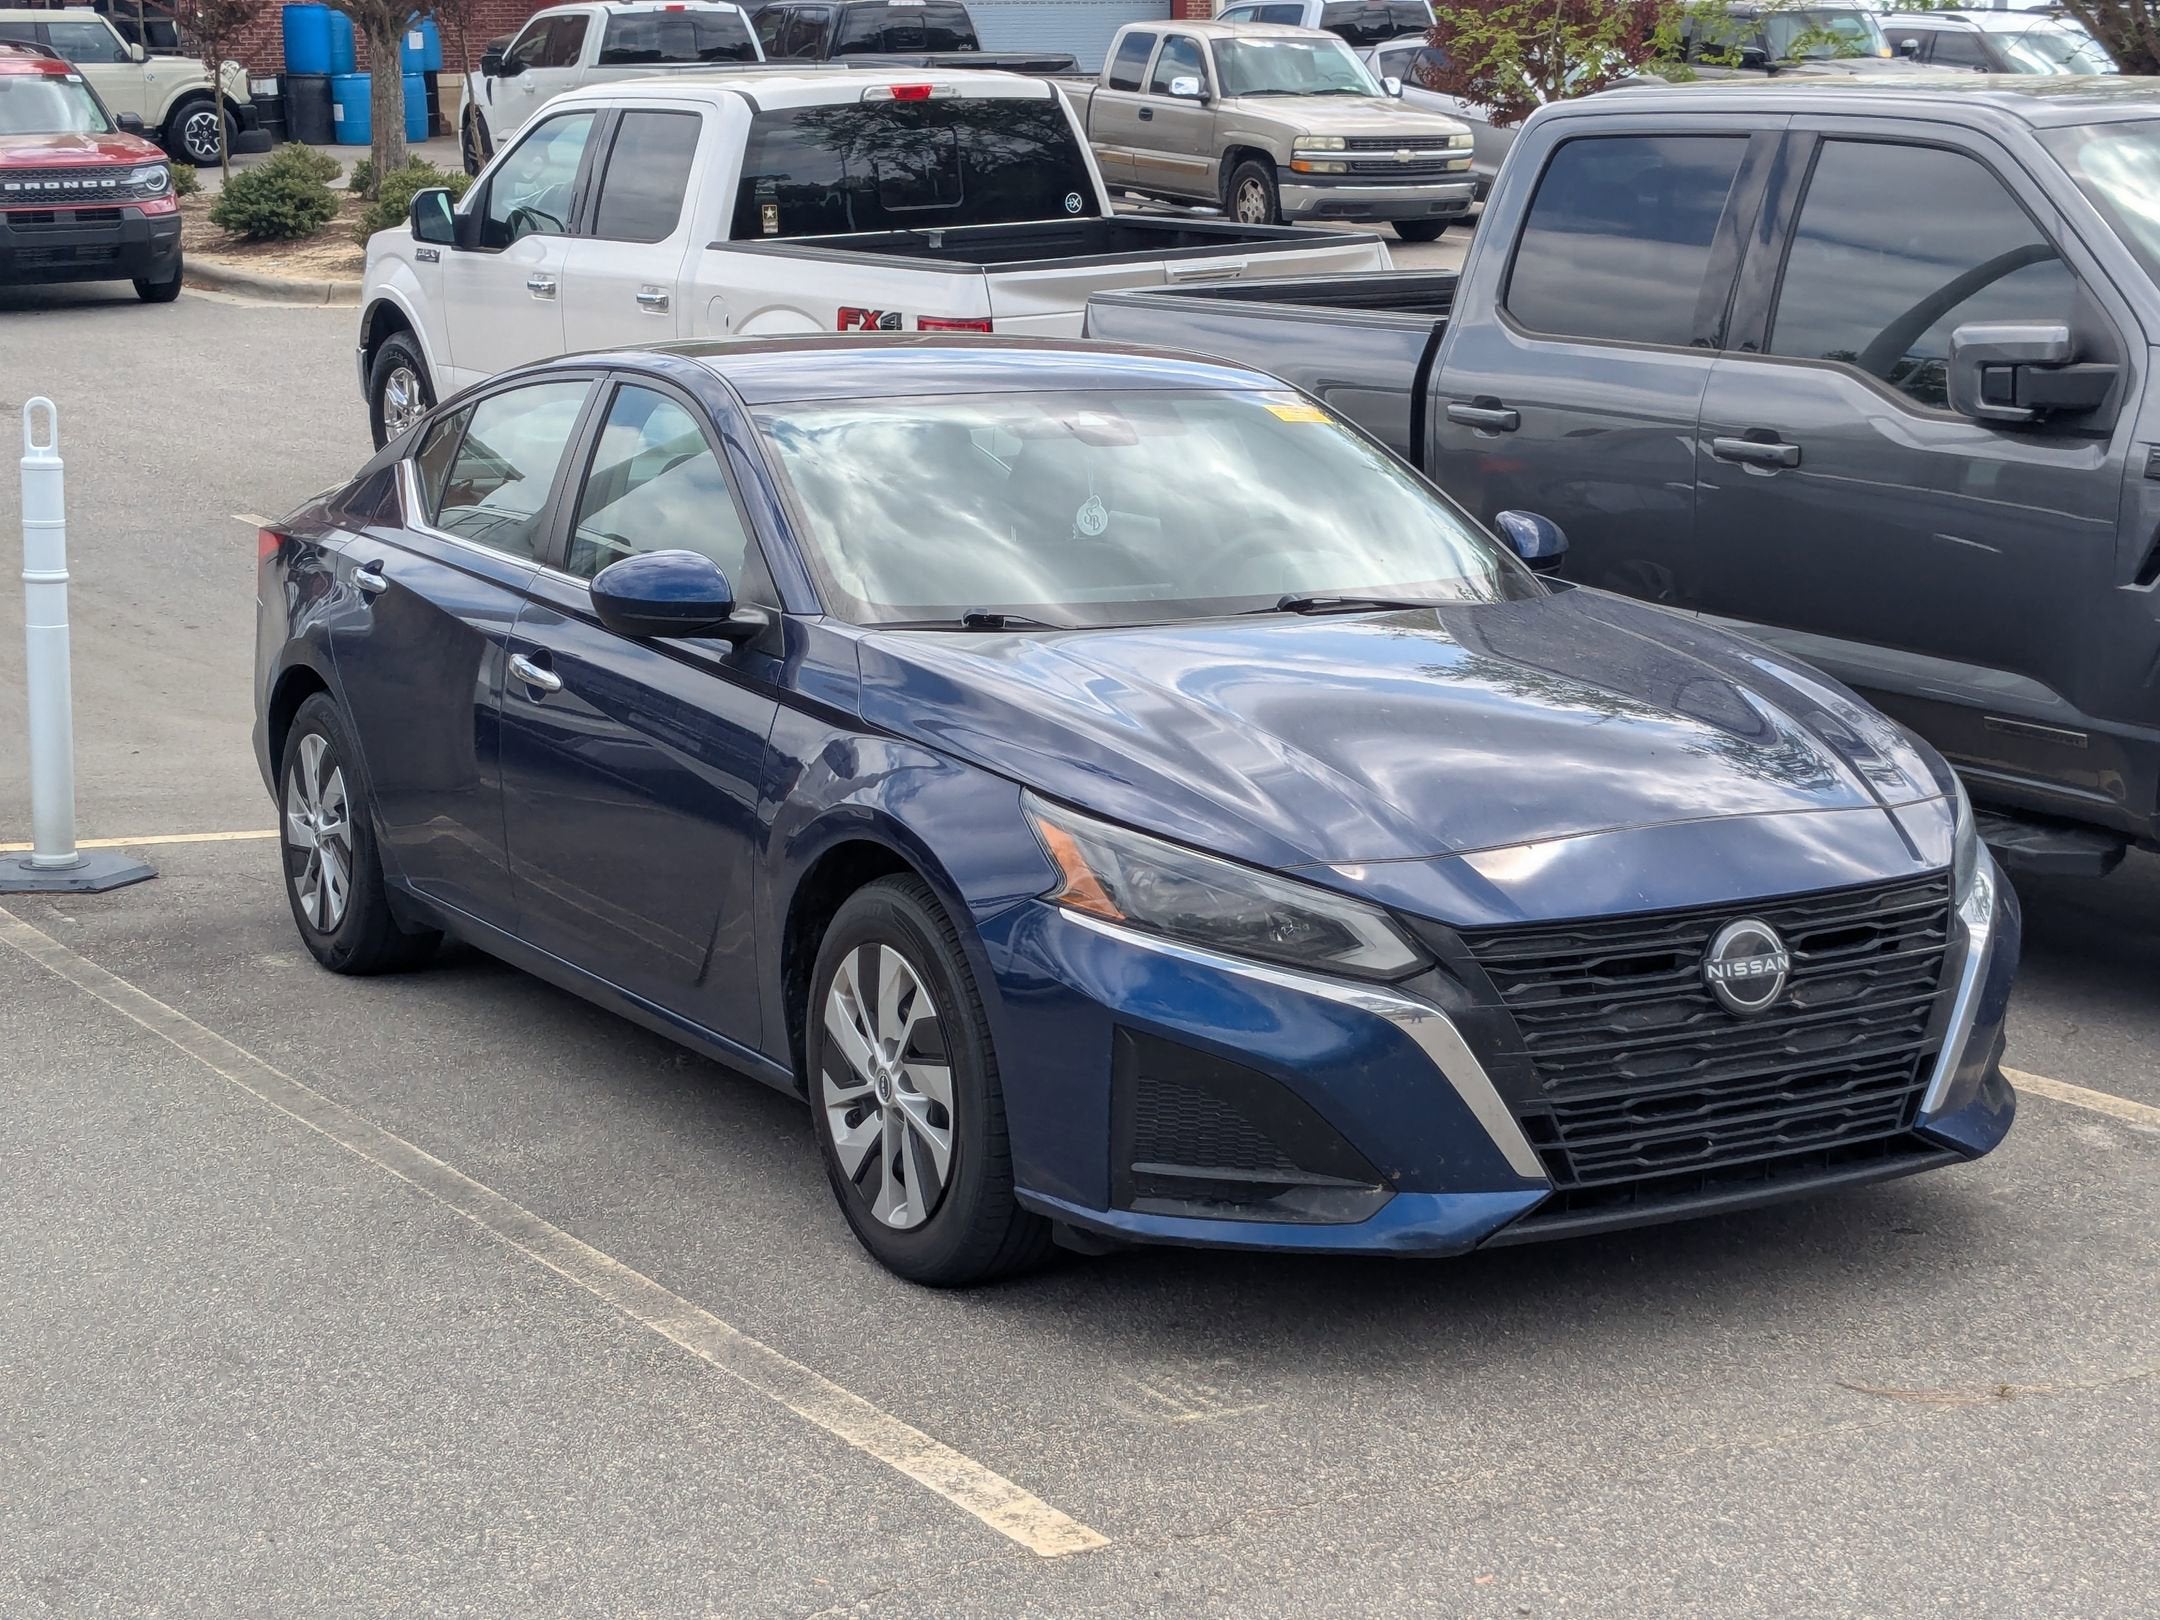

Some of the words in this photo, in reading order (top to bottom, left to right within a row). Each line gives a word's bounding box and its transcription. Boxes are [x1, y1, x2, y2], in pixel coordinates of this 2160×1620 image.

[4, 180, 117, 191] BRONCO
[837, 306, 903, 331] FX4
[1707, 954, 1790, 979] NISSAN
